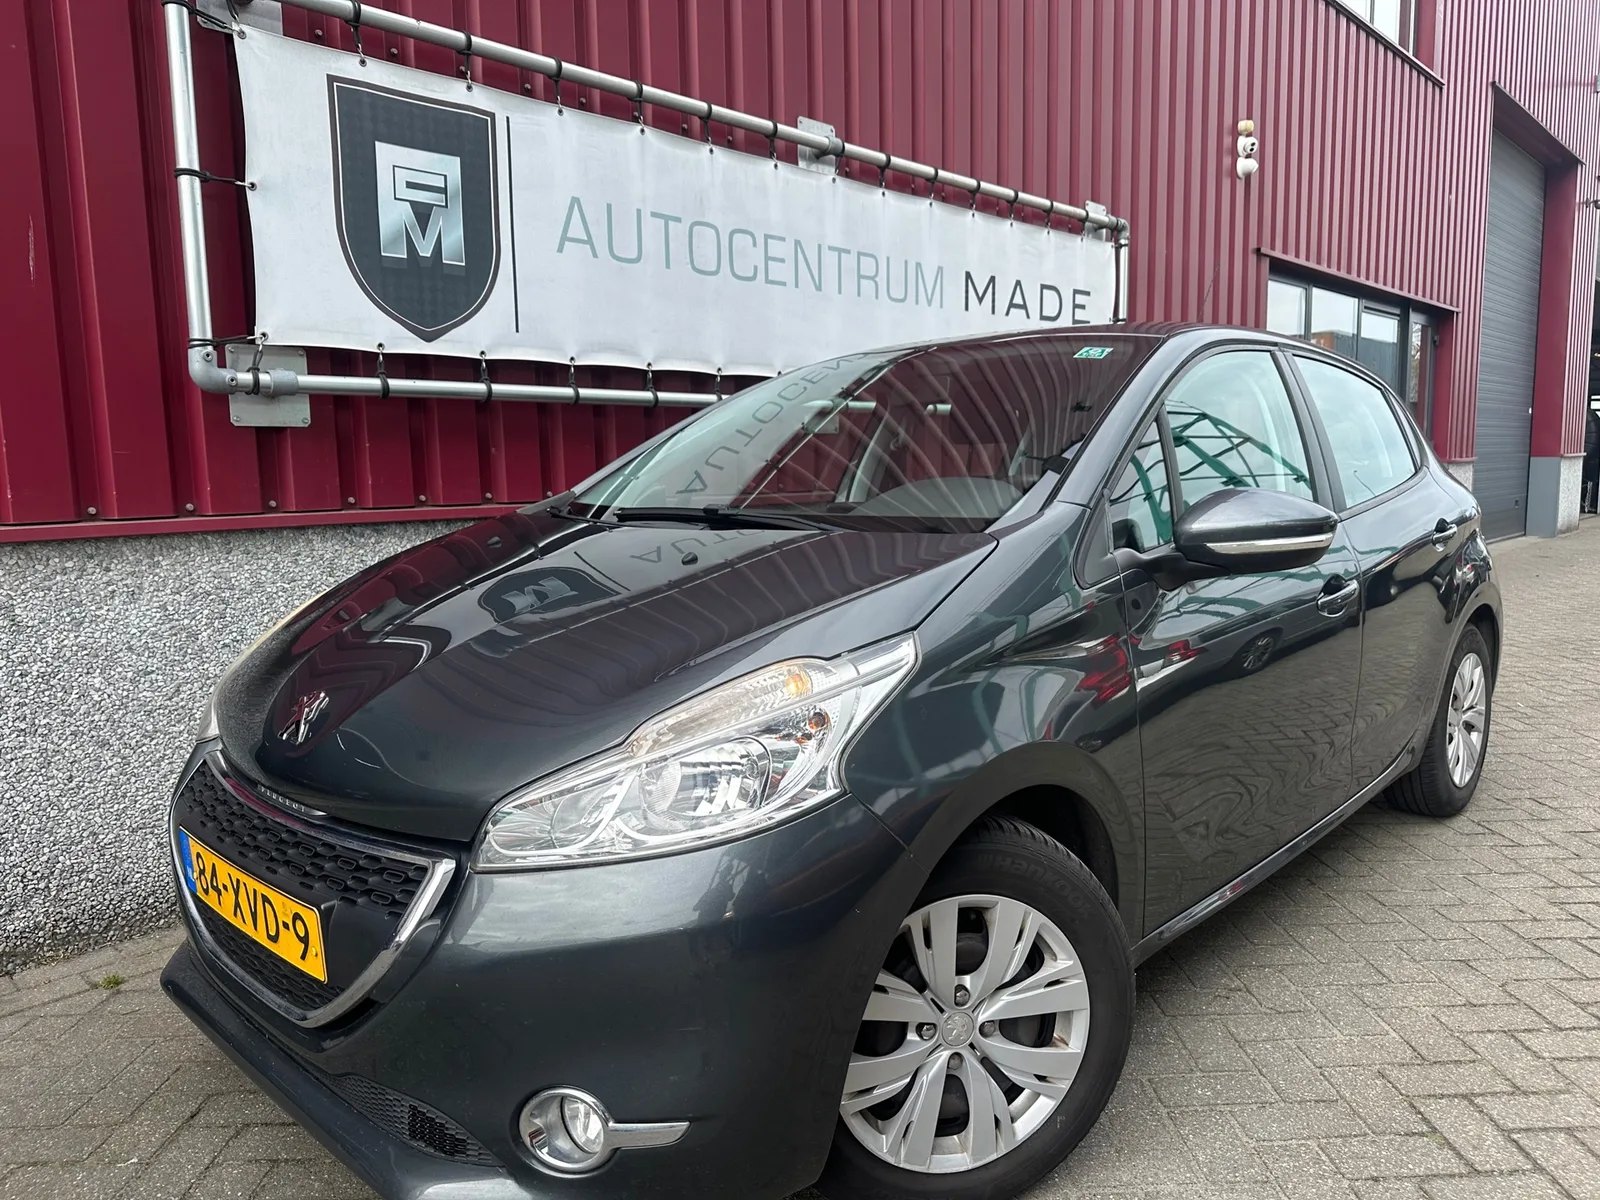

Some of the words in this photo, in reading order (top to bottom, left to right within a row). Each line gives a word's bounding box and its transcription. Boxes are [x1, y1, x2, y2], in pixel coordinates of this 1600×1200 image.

[556, 196, 944, 309] AUTOCENTRUM
[964, 270, 1091, 325] MADE
[196, 852, 310, 961] 84-XVD-9
